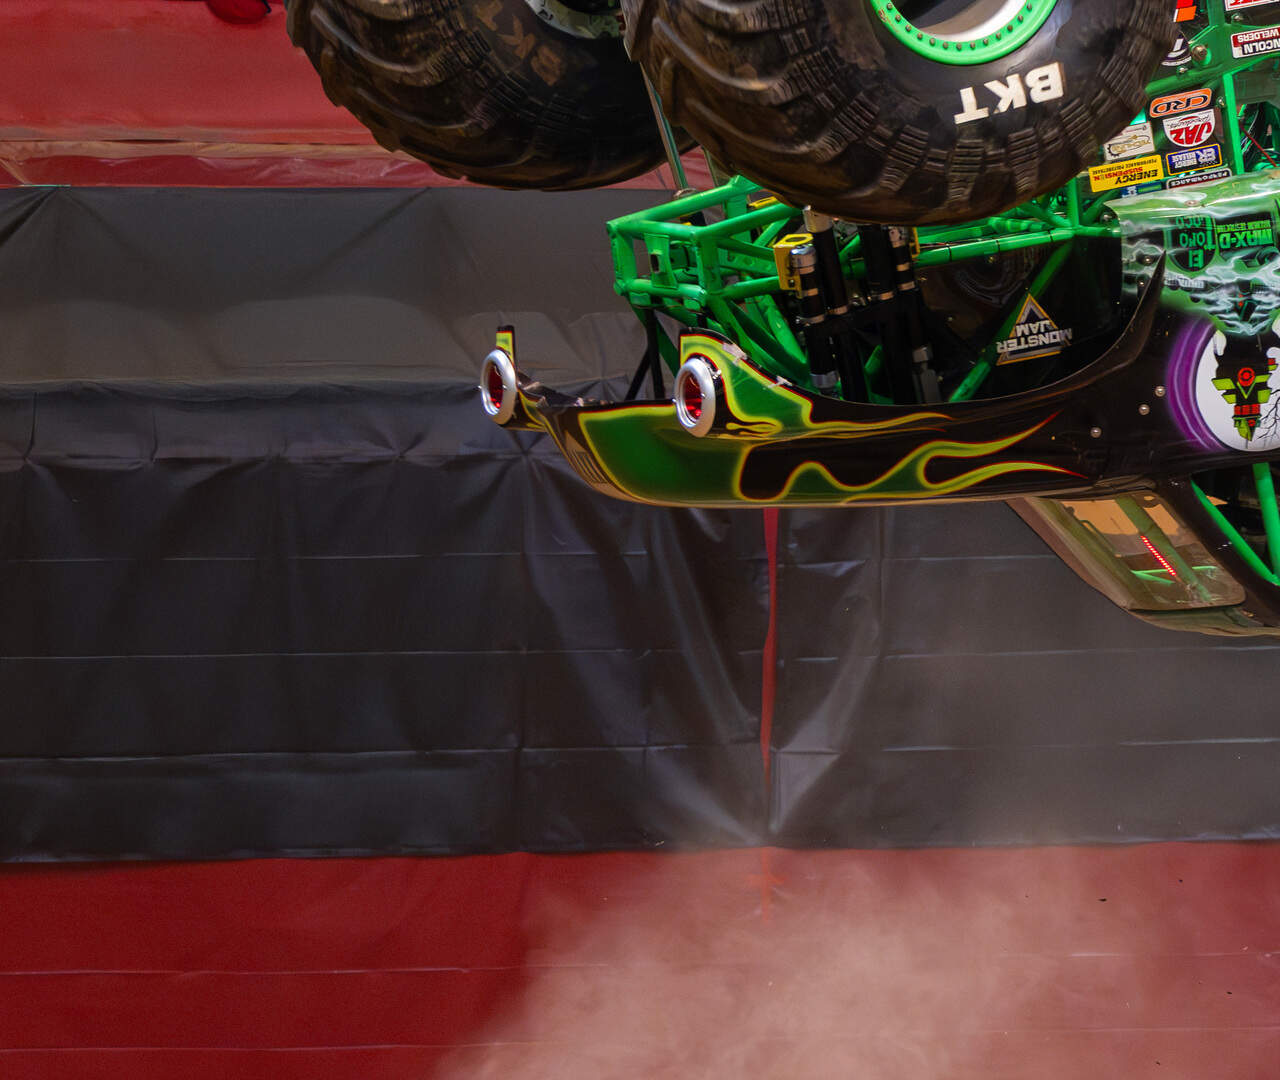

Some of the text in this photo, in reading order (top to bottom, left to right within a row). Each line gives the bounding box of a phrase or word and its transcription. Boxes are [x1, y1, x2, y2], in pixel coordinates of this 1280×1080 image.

[1237, 28, 1280, 42] WELDERS
[954, 62, 1065, 125] BKT
[1151, 95, 1208, 114] CRD
[1170, 122, 1213, 145] JAZ
[1115, 169, 1158, 184] ENERGY
[1219, 228, 1273, 249] MAX-D
[1015, 320, 1050, 336] JAM
[996, 328, 1072, 353] MONSTER
